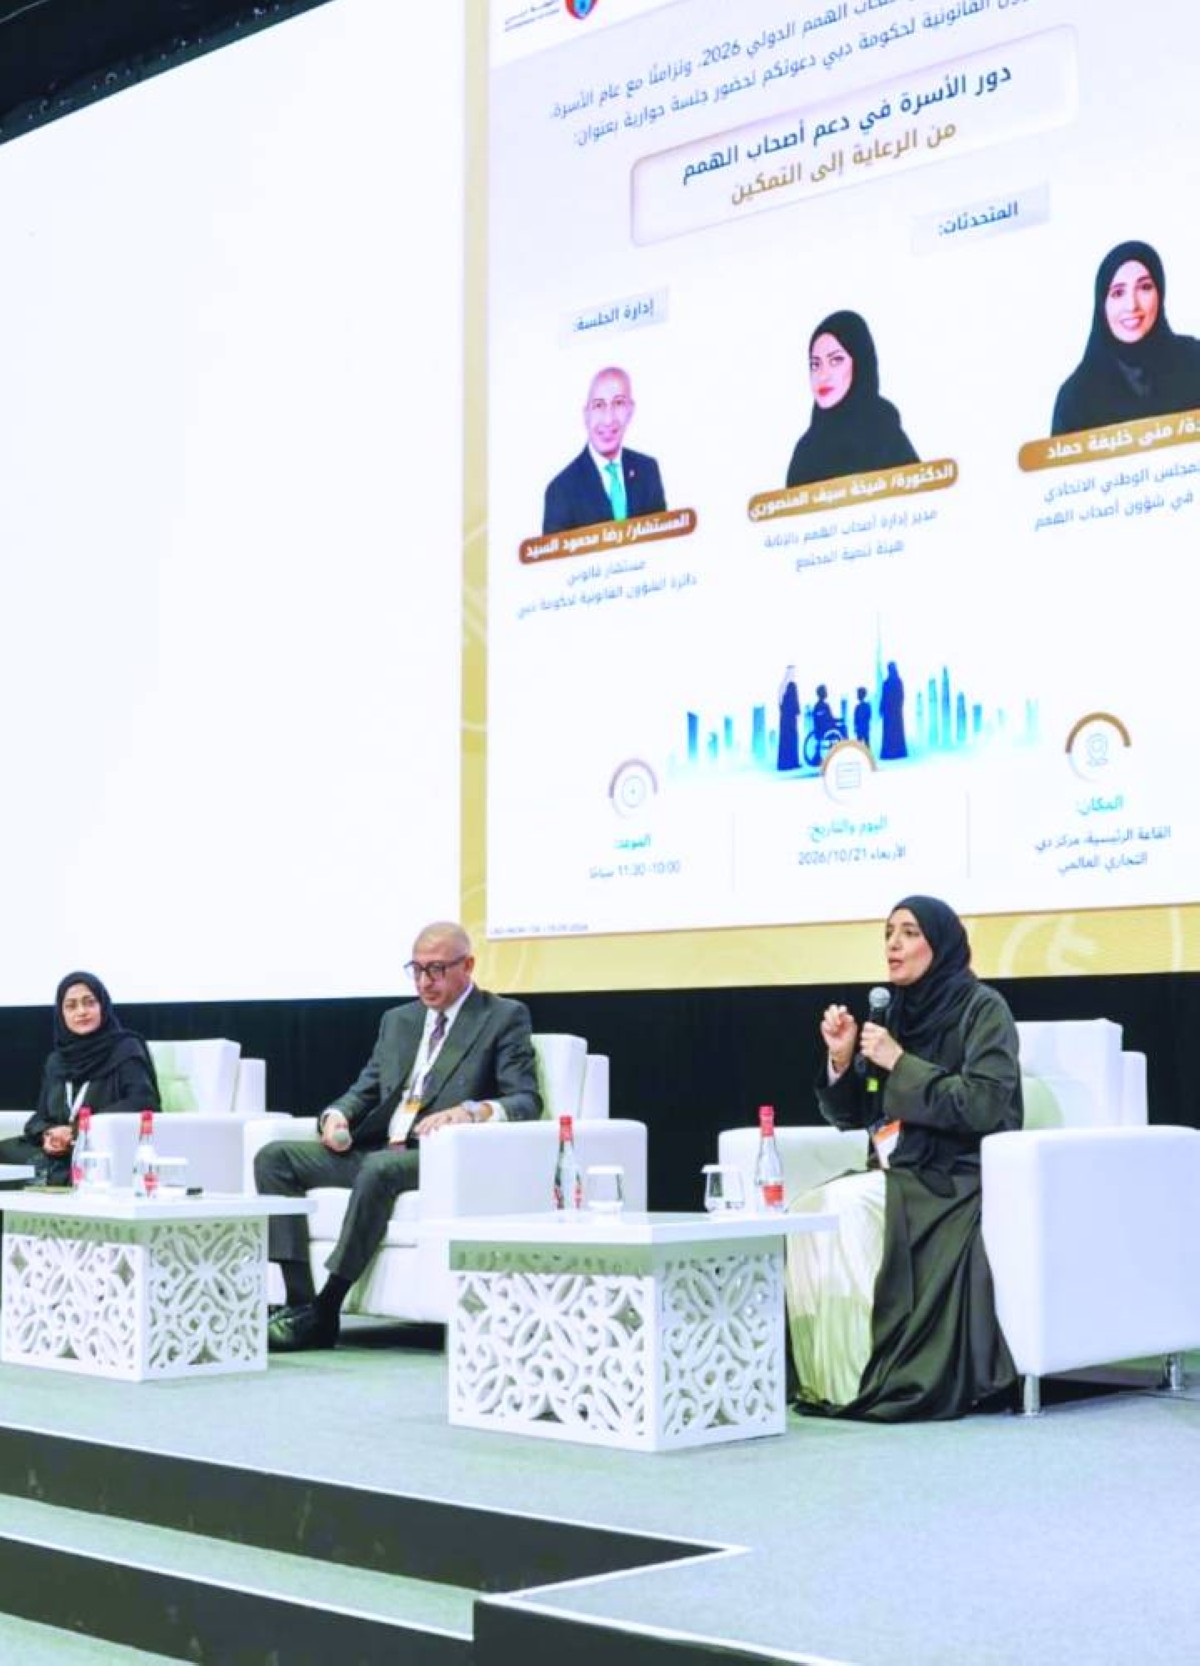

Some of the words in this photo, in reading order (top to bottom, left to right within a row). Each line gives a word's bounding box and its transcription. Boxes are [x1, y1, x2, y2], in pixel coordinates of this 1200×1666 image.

[802, 2, 847, 38] الهمم
[859, 17, 916, 50] لحكومة
[747, 20, 796, 58] الدولي
[762, 53, 816, 88] دعوتكم
[823, 43, 853, 70] دبي
[599, 83, 620, 107] عام
[626, 78, 643, 99] مع
[713, 69, 757, 103] لحضور
[900, 74, 966, 115] الأسرة
[974, 65, 1012, 97] دور
[670, 88, 708, 112] جلسة
[623, 104, 665, 128] حوارية
[813, 114, 850, 146] دعم
[859, 102, 892, 133] في
[746, 118, 805, 162] أصحاب
[852, 129, 918, 167] الرعاية
[926, 123, 957, 149] من
[682, 145, 738, 186] الهمم
[810, 149, 844, 183] إلى
[730, 162, 802, 206] التمكين
[938, 200, 1018, 237] المتحدثات:
[624, 298, 654, 322] إدارة
[1046, 440, 1083, 460] حماد
[1087, 429, 1133, 452] خليفة
[1138, 423, 1173, 448] منى
[1100, 468, 1149, 496] الوطني
[1078, 499, 1119, 522] أصحاب
[1170, 489, 1194, 512] في
[1034, 508, 1074, 532] الهمم
